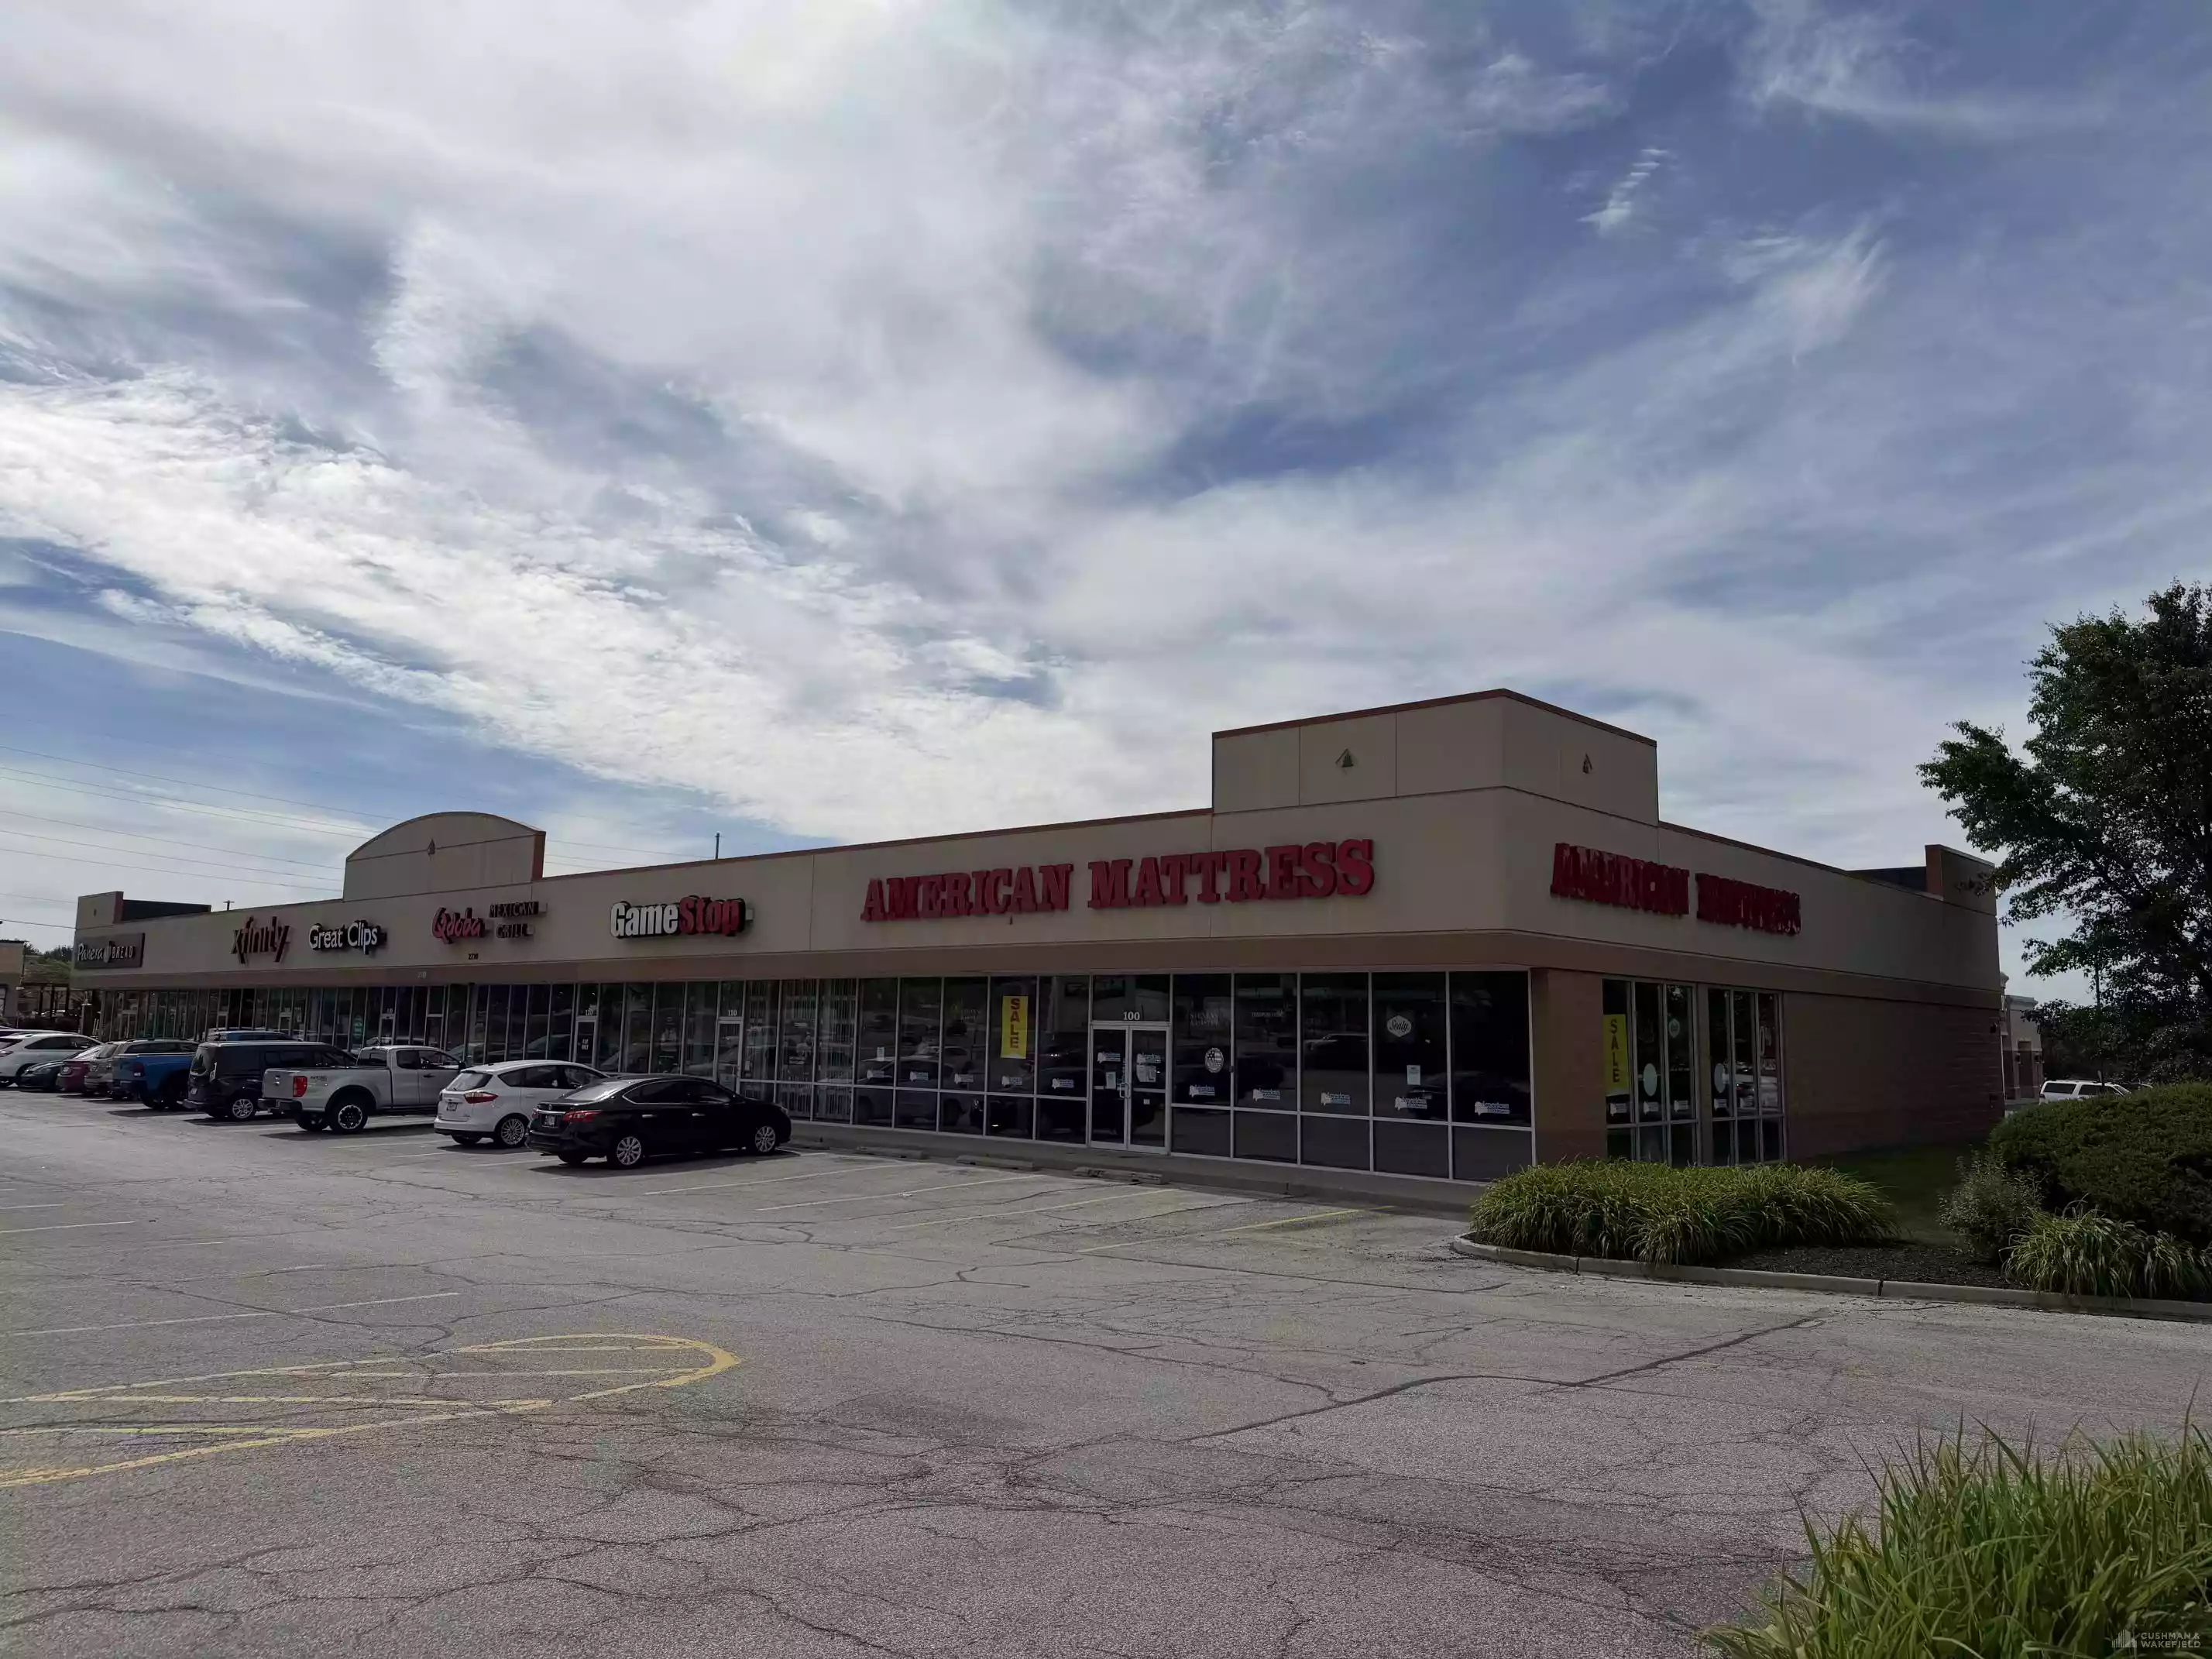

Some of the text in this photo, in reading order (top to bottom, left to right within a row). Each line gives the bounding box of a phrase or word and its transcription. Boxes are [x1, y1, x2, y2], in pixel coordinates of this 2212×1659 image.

[860, 839, 1375, 922] AMERICAN MATTRESS
[309, 920, 380, 956] Great Clips
[431, 907, 486, 944] Qdoba
[610, 895, 746, 939] GameStop
[77, 943, 134, 961] Panera BREAD
[231, 915, 291, 964] xfinity
[1009, 998, 1021, 1049] SALE
[1123, 1012, 1140, 1021] 100
[1610, 1018, 1620, 1084] SALE
